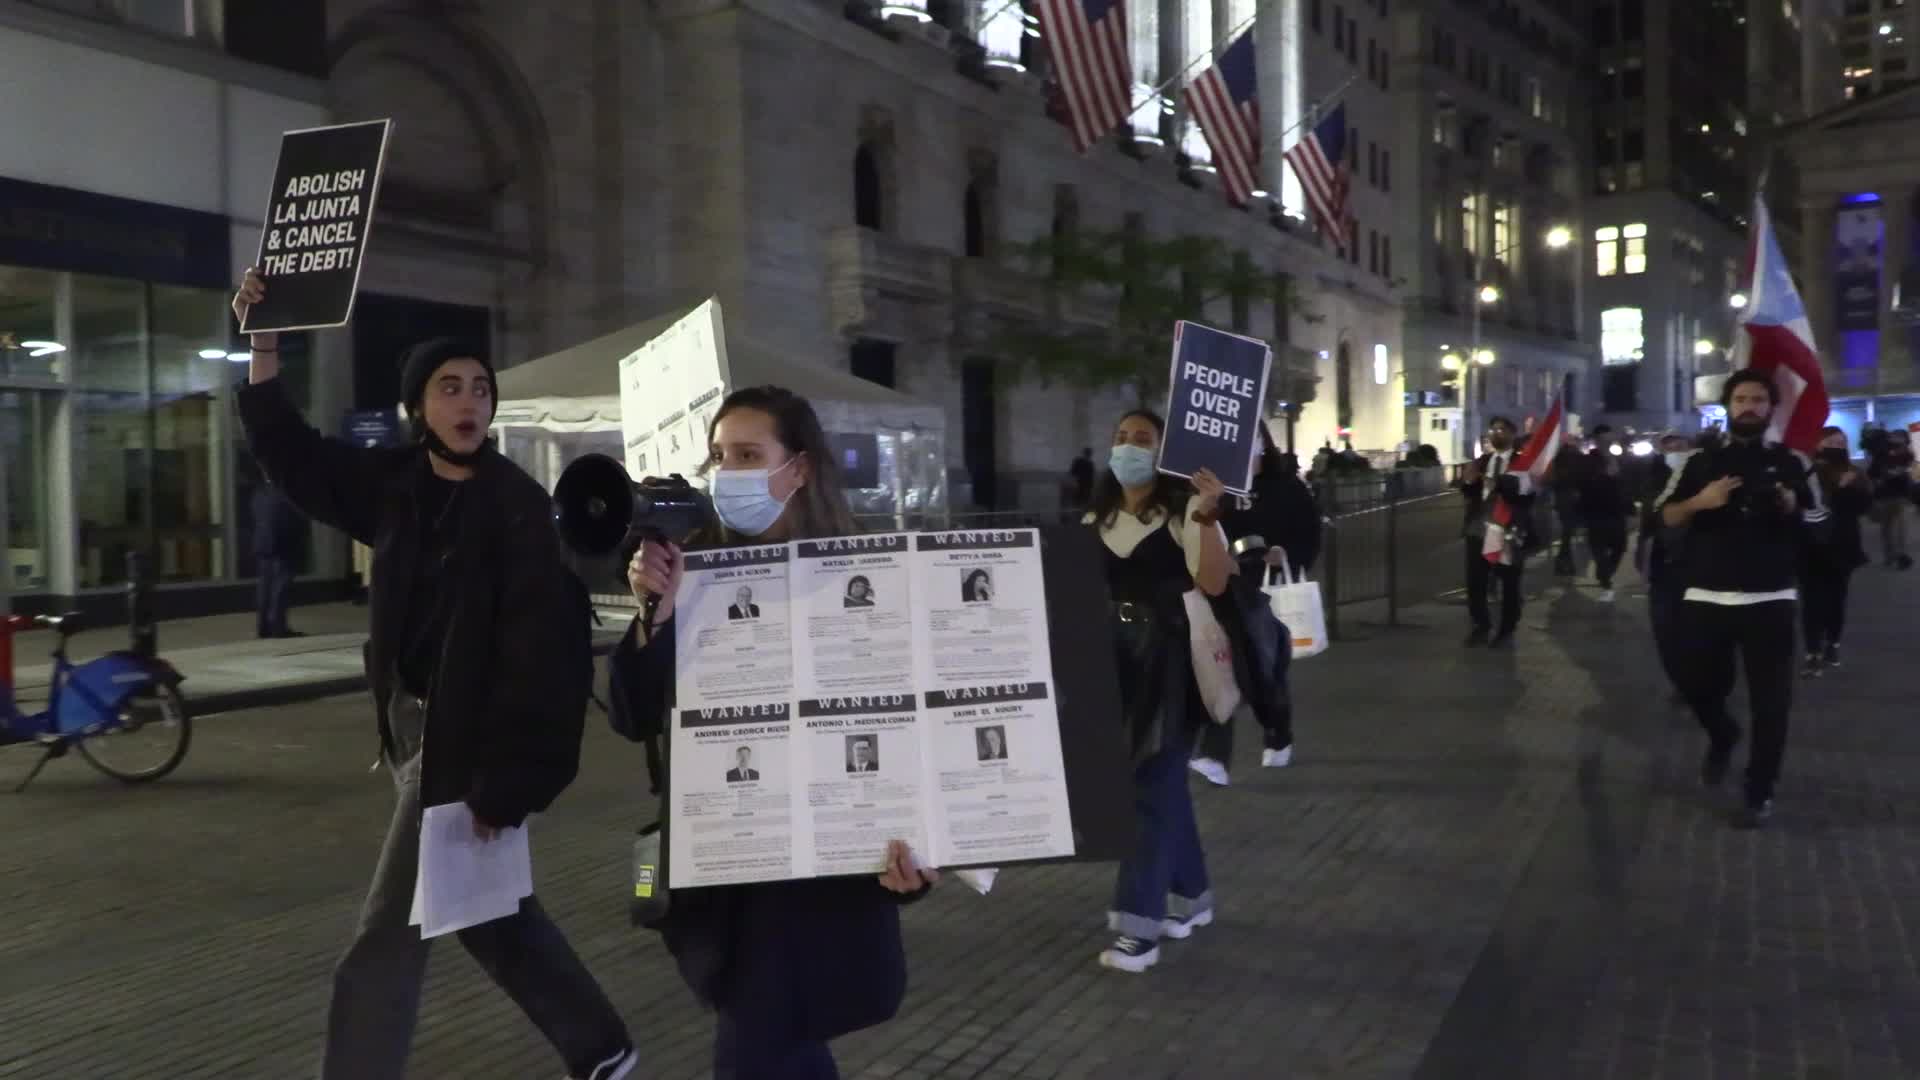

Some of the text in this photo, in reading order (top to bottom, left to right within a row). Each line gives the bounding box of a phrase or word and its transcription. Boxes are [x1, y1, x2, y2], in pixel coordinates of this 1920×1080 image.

[284, 169, 365, 198] ABOLISH
[274, 195, 360, 224] LA JUNTA
[267, 221, 357, 250] & CANCEL
[263, 247, 355, 276] THE DEBT!
[1183, 360, 1255, 398] PEOPLE
[1190, 388, 1240, 419] OVER
[1183, 410, 1240, 443] DEBT!
[815, 535, 897, 552] WANTED
[935, 530, 1016, 545] WANTED
[702, 546, 782, 563] WANTED
[943, 682, 1029, 700] WANTED
[819, 693, 904, 710] WANTED
[700, 703, 785, 720] WANTED
[694, 729, 731, 738] ANDREW
[732, 727, 765, 736] GEORGE
[805, 719, 844, 728] ANTONIO
